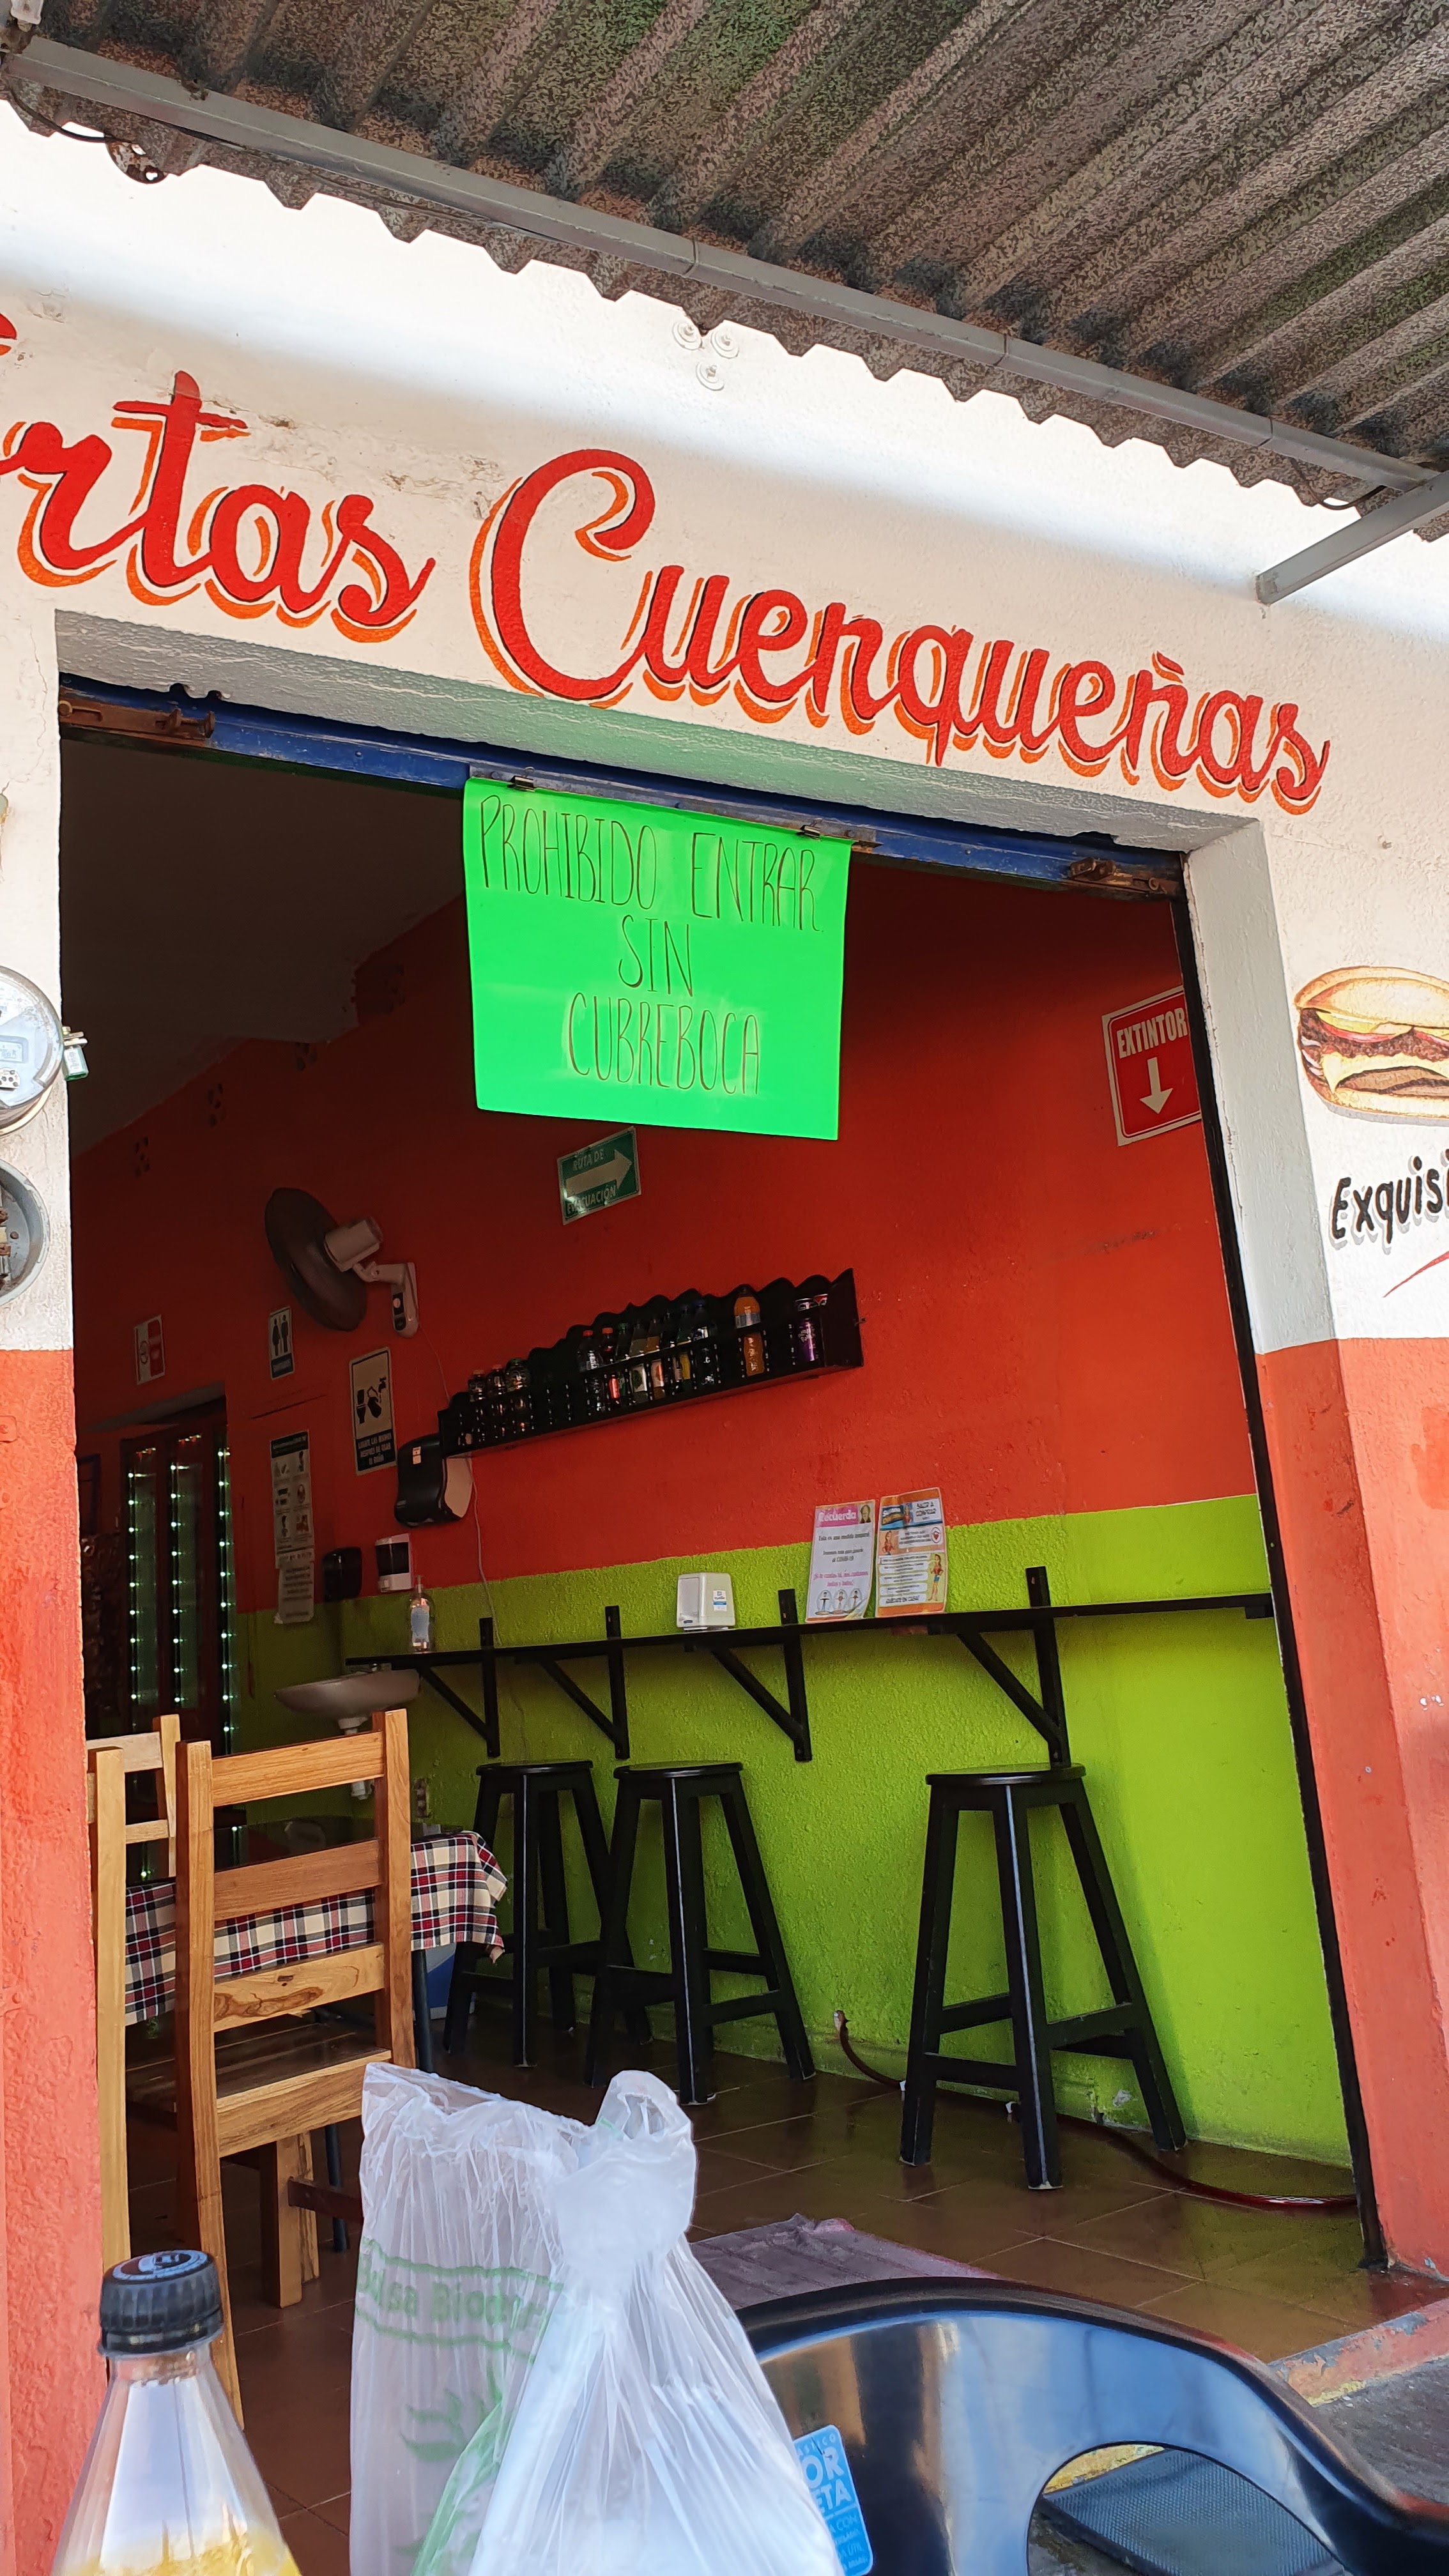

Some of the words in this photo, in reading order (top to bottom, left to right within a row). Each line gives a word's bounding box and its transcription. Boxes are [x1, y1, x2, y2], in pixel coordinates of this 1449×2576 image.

[0, 368, 437, 643] rtas
[470, 448, 1330, 815] Cuenqueñas
[480, 794, 657, 910] PROHIBIDO
[692, 832, 820, 931] ENTRAR
[618, 914, 693, 997] SIN
[568, 992, 759, 1095] CUBREBOCA
[1116, 1007, 1188, 1059] EXTINTOR
[572, 1153, 593, 1171] RUTA
[594, 1148, 604, 1162] DE
[817, 1509, 857, 1522] Recuerda
[797, 2433, 836, 2457] ASTICO
[801, 2446, 845, 2489] OR
[809, 2478, 852, 2513] ETA
